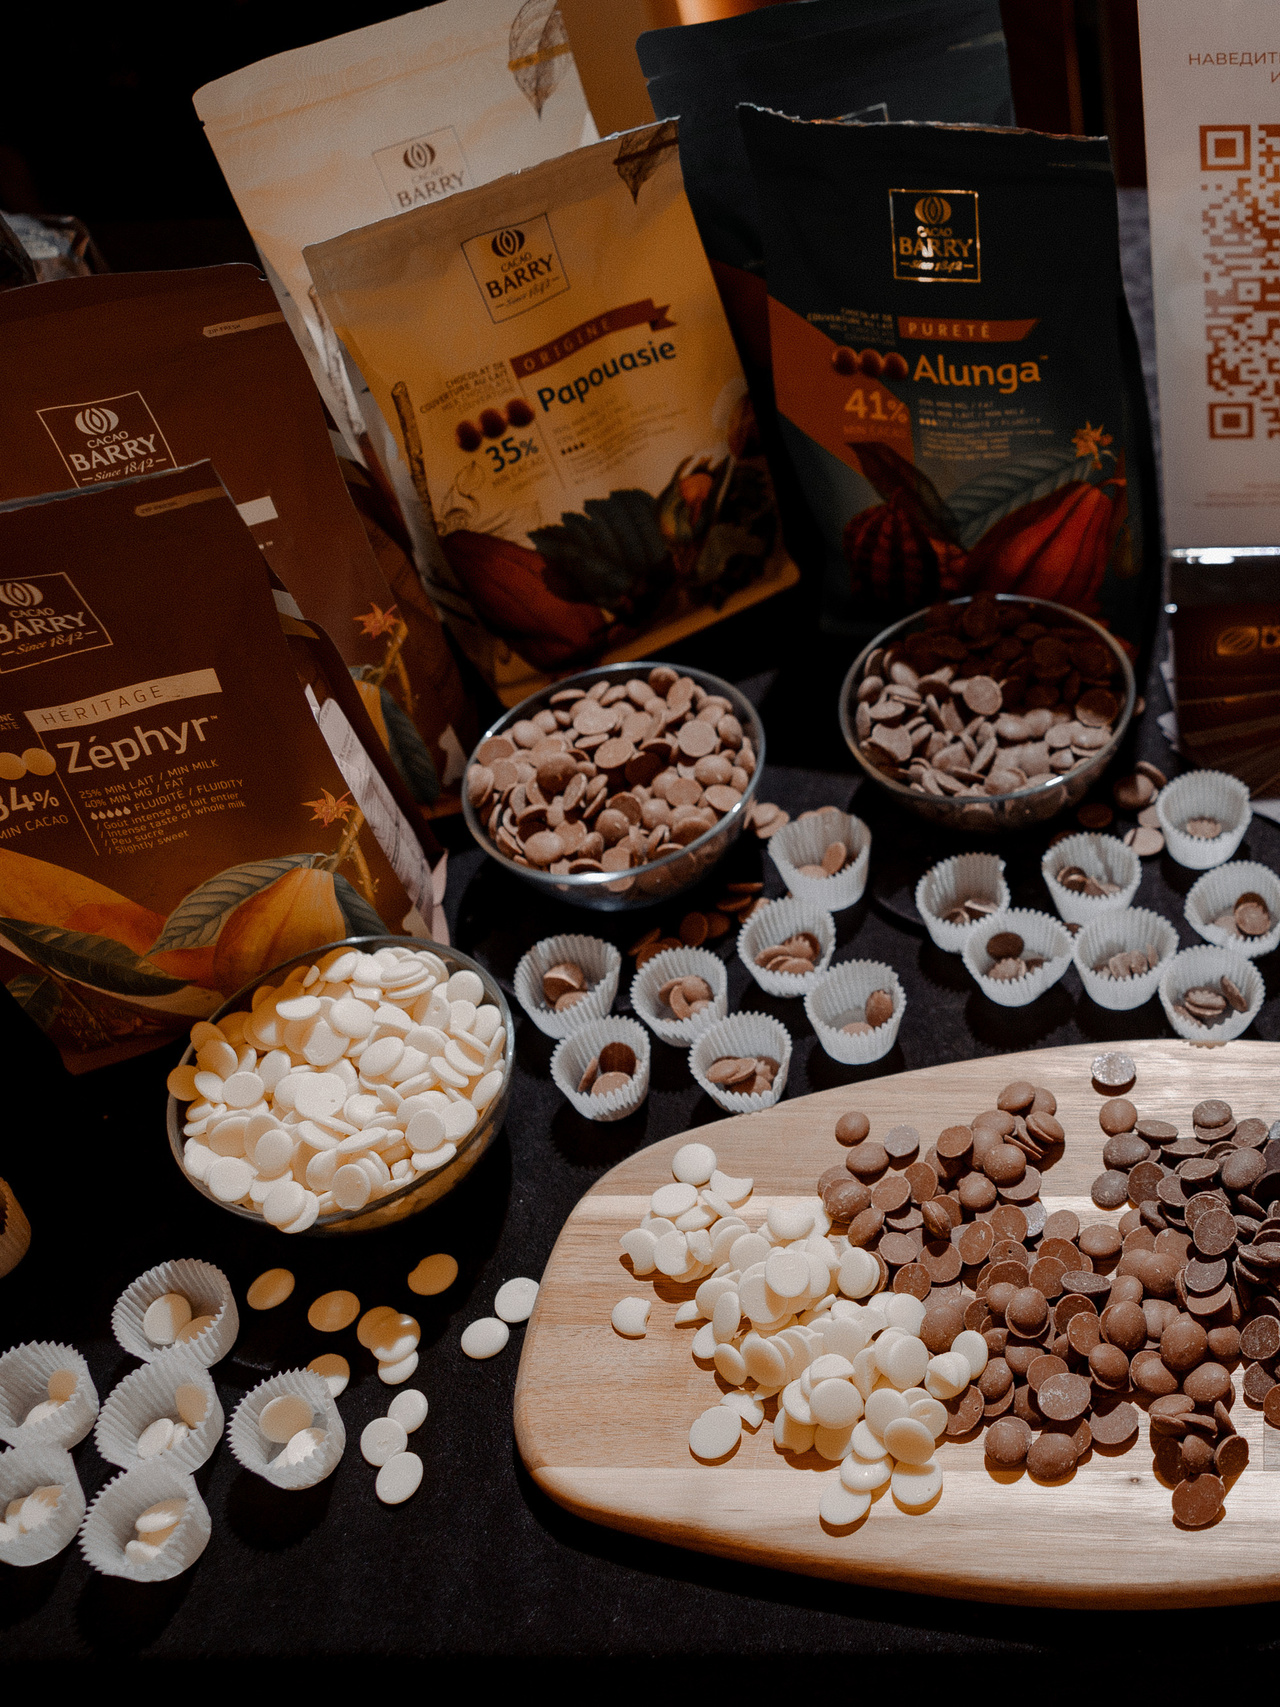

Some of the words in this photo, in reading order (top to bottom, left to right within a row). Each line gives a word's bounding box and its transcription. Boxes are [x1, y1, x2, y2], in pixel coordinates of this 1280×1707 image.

[397, 170, 464, 207] BARRY
[501, 251, 533, 273] CACAO
[899, 236, 974, 258] BARRY
[485, 254, 553, 299] BARRY
[522, 319, 609, 373] ORIGINE
[907, 321, 991, 339] PURETÉ
[537, 340, 677, 412] Papouasie
[844, 388, 909, 423] 41%
[68, 433, 157, 472] BARRY
[87, 430, 129, 449] CACAO
[485, 437, 539, 473] 35%
[94, 467, 121, 481] Since
[124, 458, 155, 475] 1842
[8, 606, 55, 619] CACAO
[16, 640, 48, 655] Since
[50, 631, 84, 649] 1842
[41, 684, 164, 725] HÉRITAGE
[79, 788, 102, 799] 25%
[104, 784, 127, 795] MIN
[129, 774, 154, 790] LAIT
[167, 765, 190, 778] MIN
[192, 758, 219, 771] MILK
[85, 798, 108, 809] 40%
[109, 793, 132, 805] MIN
[133, 787, 153, 799] MG
[164, 777, 184, 790] FAT
[132, 808, 172, 825] intense
[174, 803, 188, 812] de
[189, 797, 207, 808] lait
[210, 792, 239, 803] entier
[134, 788, 186, 812] FLUIDITÉ
[196, 779, 243, 794] FLUIDITY
[0, 825, 22, 840] MIN
[25, 814, 69, 831] CACAO
[107, 824, 147, 838] Intense
[149, 815, 178, 829] taste
[181, 809, 192, 820] of
[195, 803, 225, 816] whole
[228, 800, 247, 810] milk
[111, 837, 132, 846] Peu
[134, 828, 164, 842] sucré
[115, 841, 154, 854] Slightly
[157, 830, 190, 845] sweet
